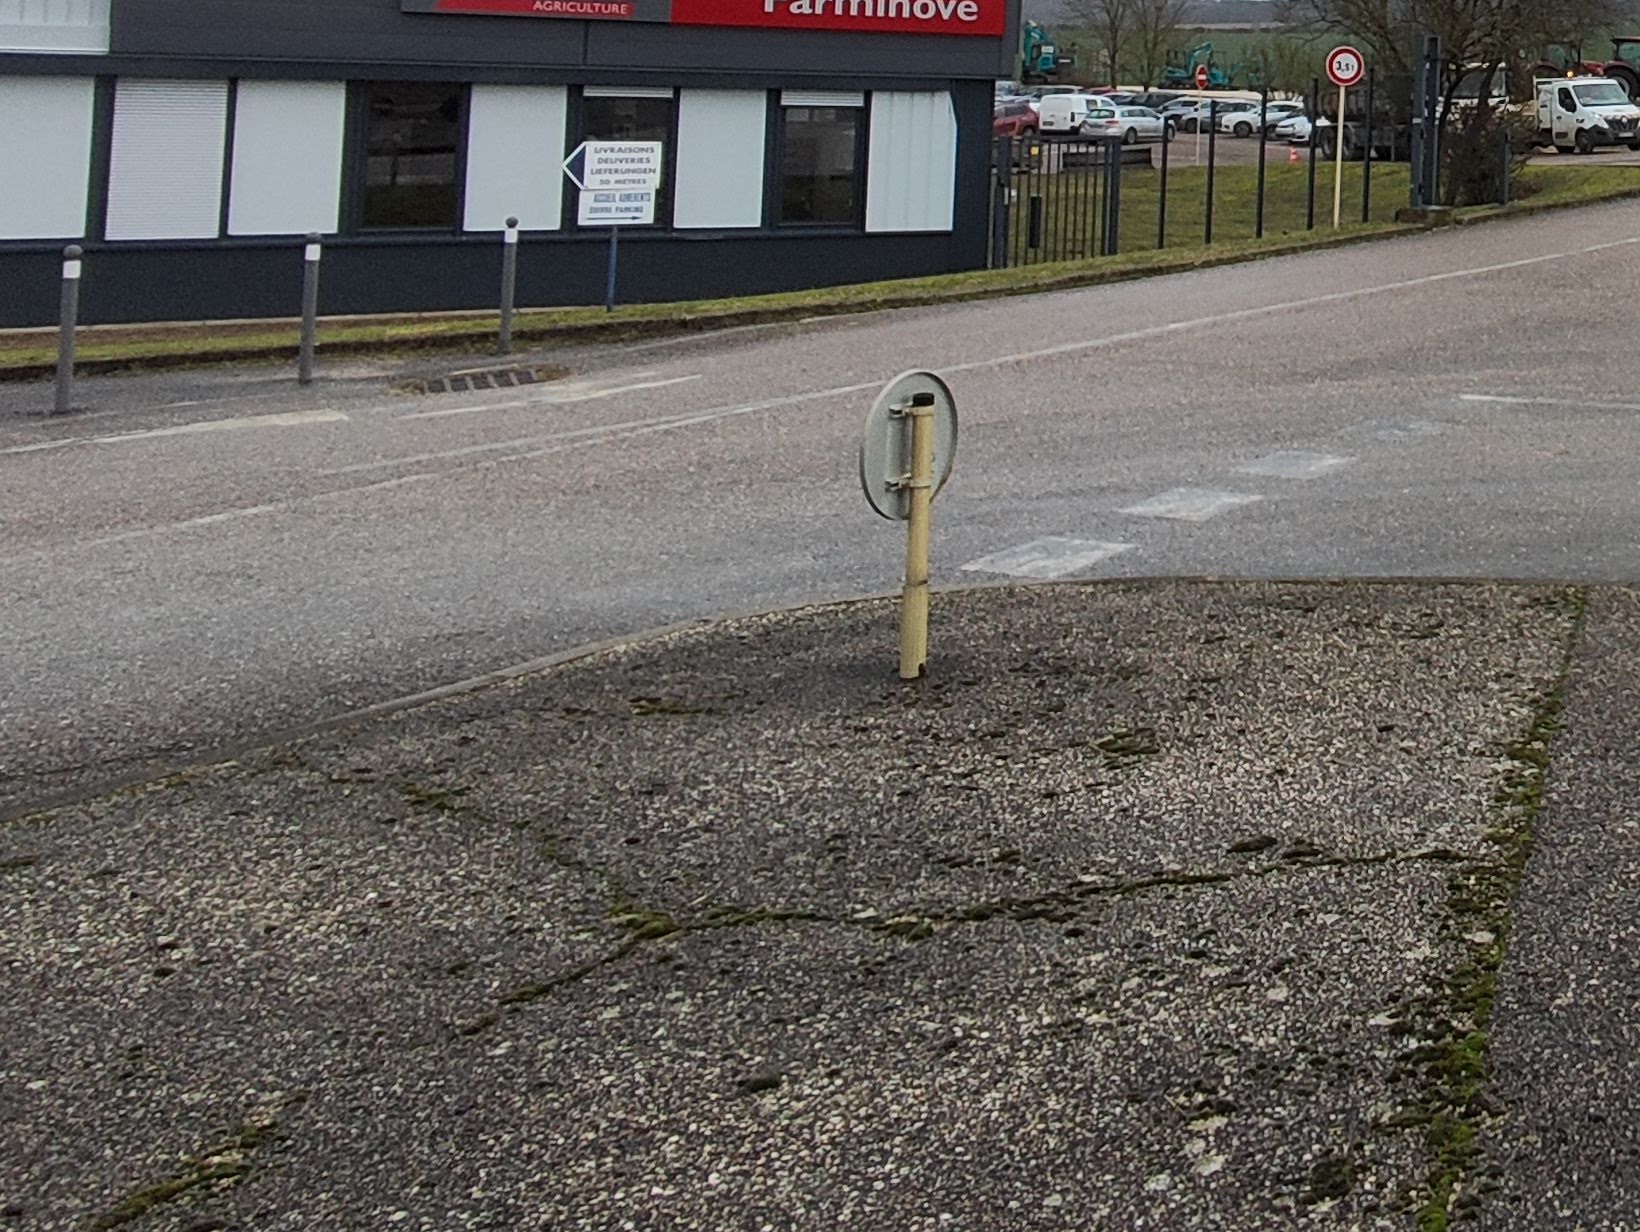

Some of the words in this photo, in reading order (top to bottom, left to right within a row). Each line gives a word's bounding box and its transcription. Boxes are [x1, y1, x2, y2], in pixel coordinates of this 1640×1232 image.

[532, 0, 628, 15] AGRICULTURE
[593, 146, 656, 155] LIVRAISONS
[597, 156, 651, 165] DELIVERIES
[590, 167, 657, 176] LIEFERUNGEN
